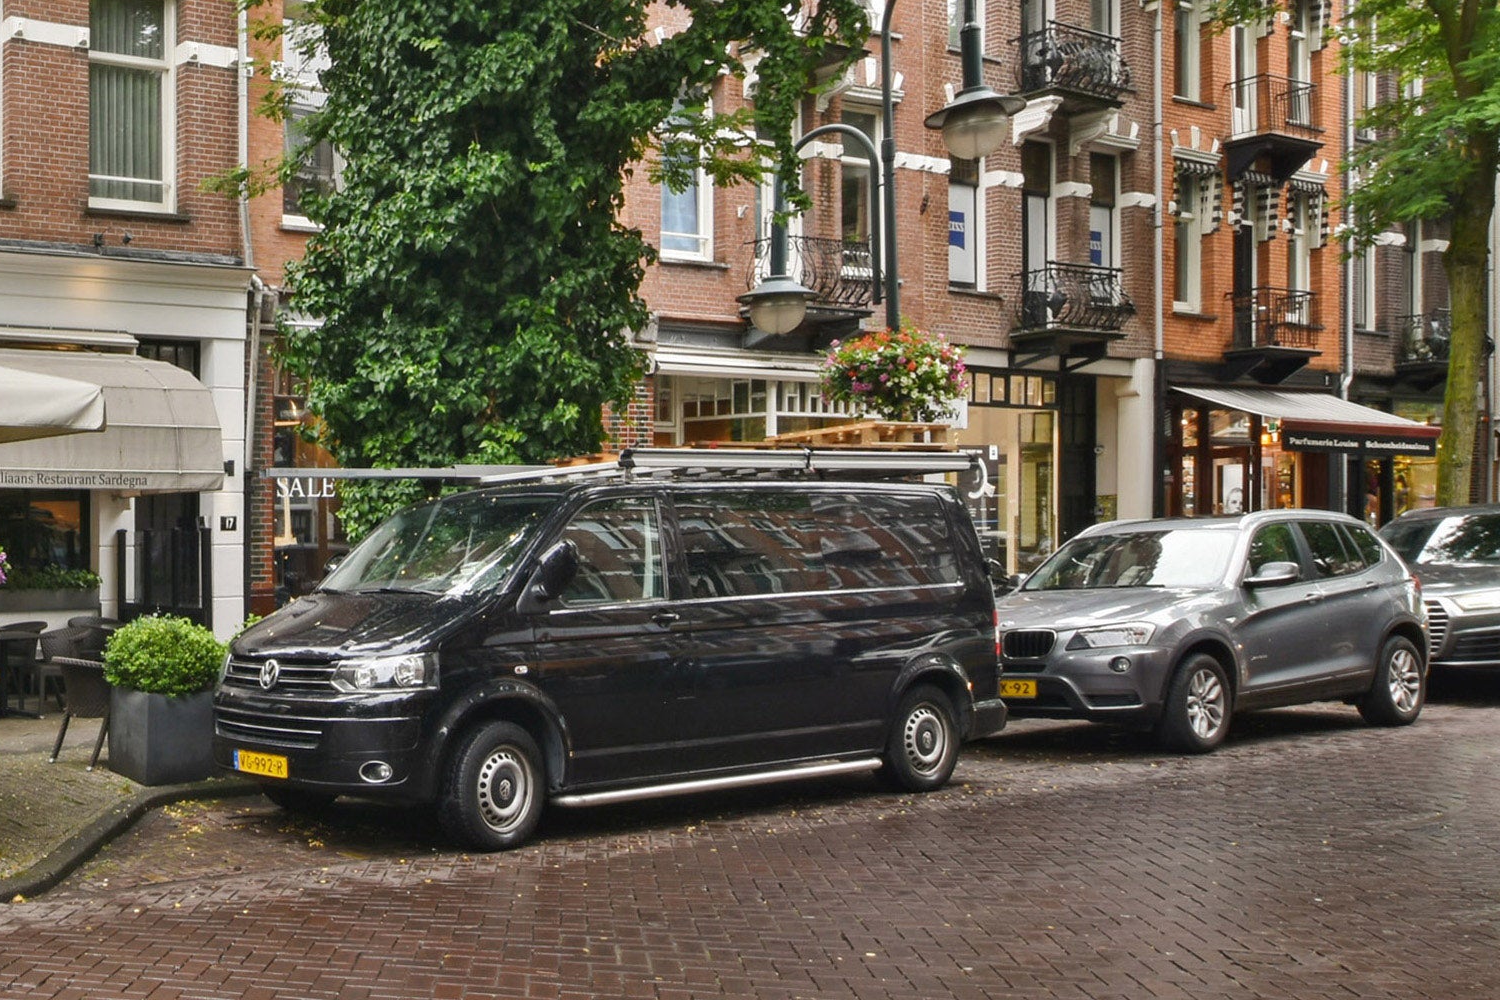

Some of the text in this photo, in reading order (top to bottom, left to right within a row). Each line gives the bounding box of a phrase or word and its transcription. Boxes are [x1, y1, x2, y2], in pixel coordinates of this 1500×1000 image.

[1289, 436, 1334, 447] Parfumerie
[1333, 439, 1359, 448] Louise
[36, 472, 96, 486] Restaurant
[98, 474, 148, 488] Sardegna
[276, 477, 336, 498] SALE
[225, 517, 235, 530] 17
